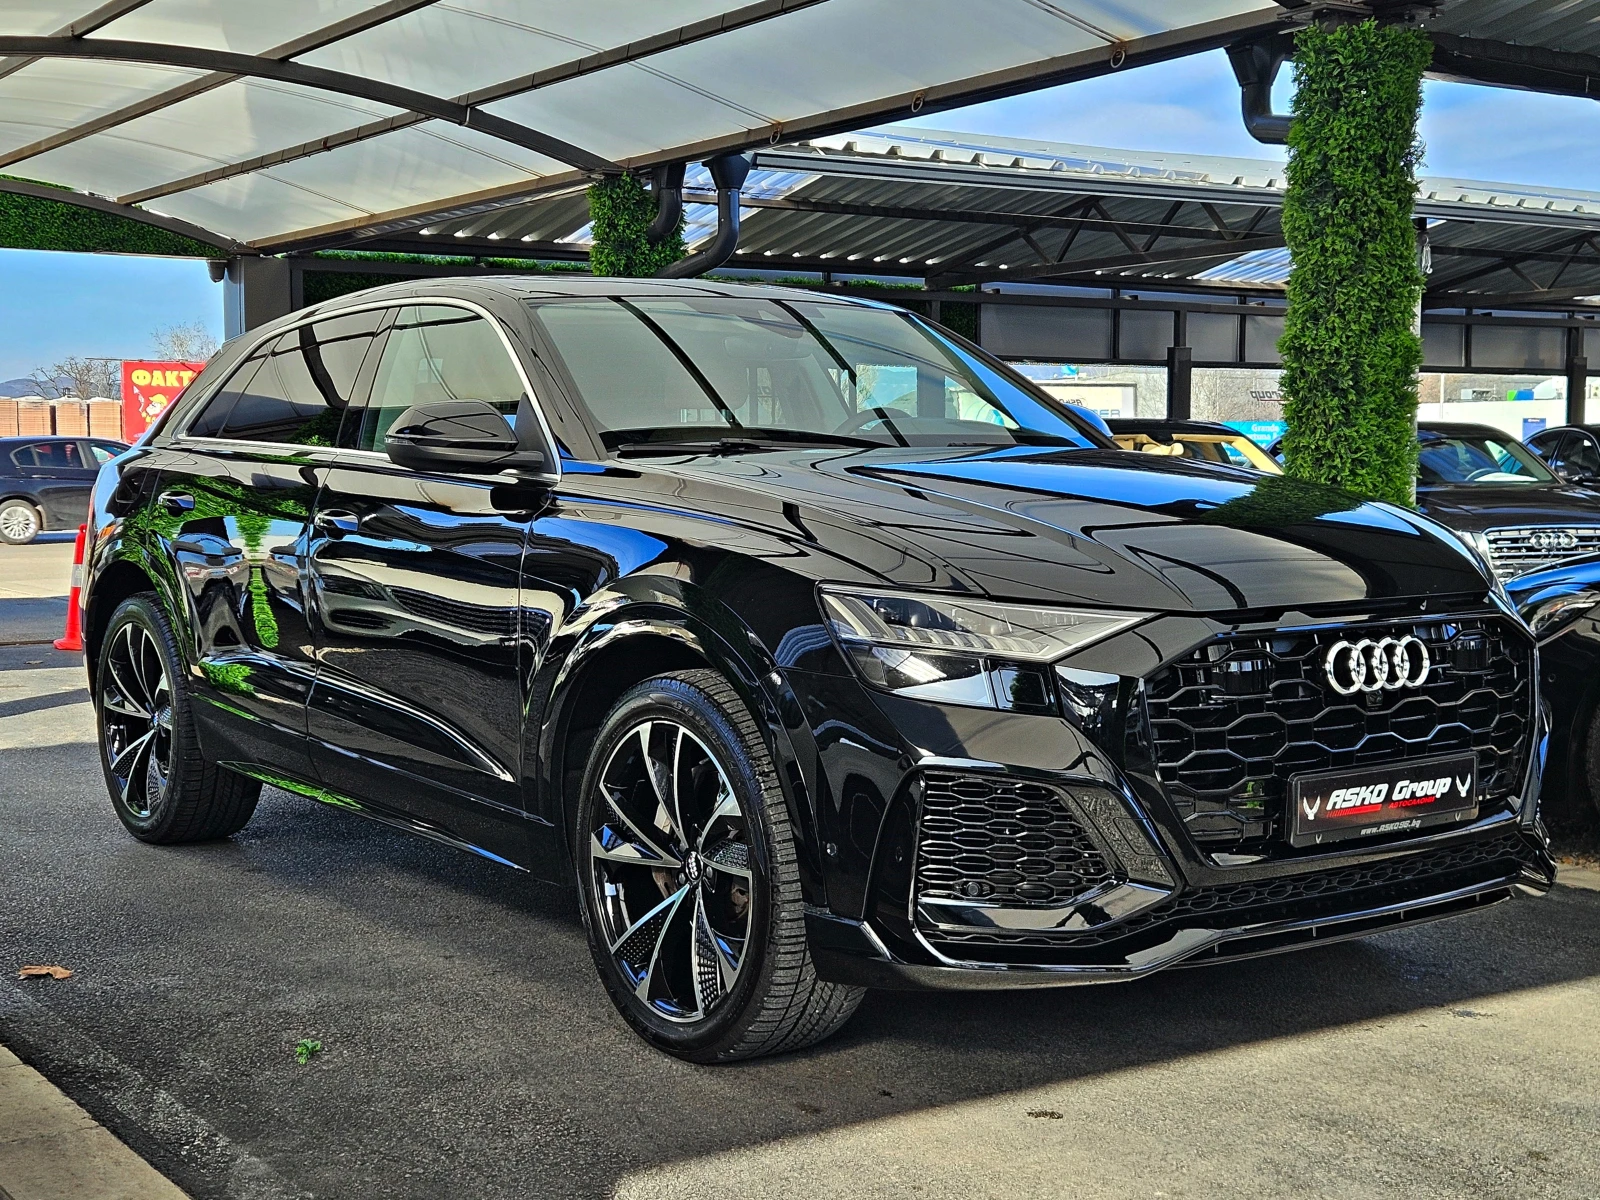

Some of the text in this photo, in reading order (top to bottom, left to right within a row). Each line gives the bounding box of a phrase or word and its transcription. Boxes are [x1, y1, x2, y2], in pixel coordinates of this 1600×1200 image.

[131, 369, 196, 387] ФАКТ
[1326, 777, 1453, 811] ASKO Group
